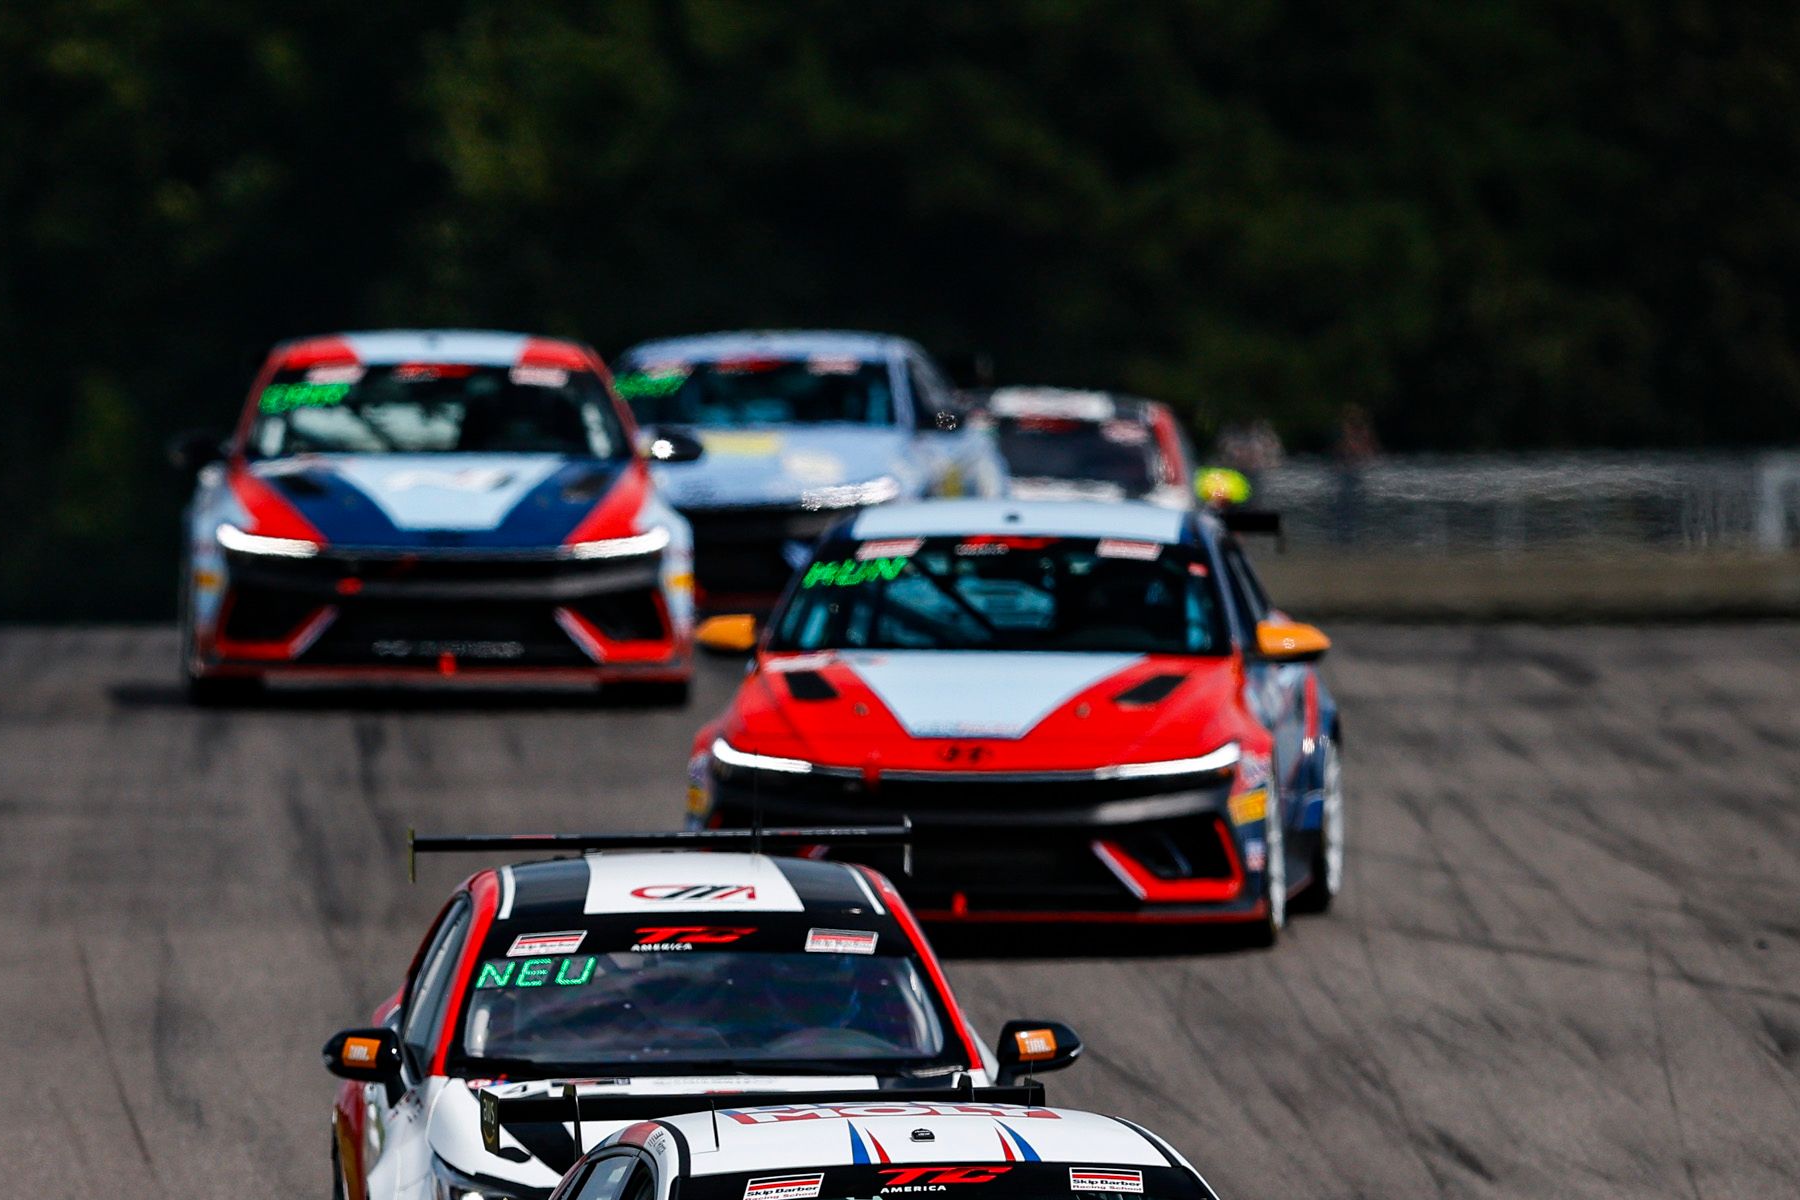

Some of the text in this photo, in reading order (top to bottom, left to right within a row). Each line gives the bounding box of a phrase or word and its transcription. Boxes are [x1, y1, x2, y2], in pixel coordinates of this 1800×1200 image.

[475, 956, 598, 989] NEU
[746, 1106, 1043, 1122] MOLY
[877, 1166, 1013, 1185] TC
[746, 1186, 819, 1198] Skip Barber
[880, 1185, 947, 1194] AMERICA
